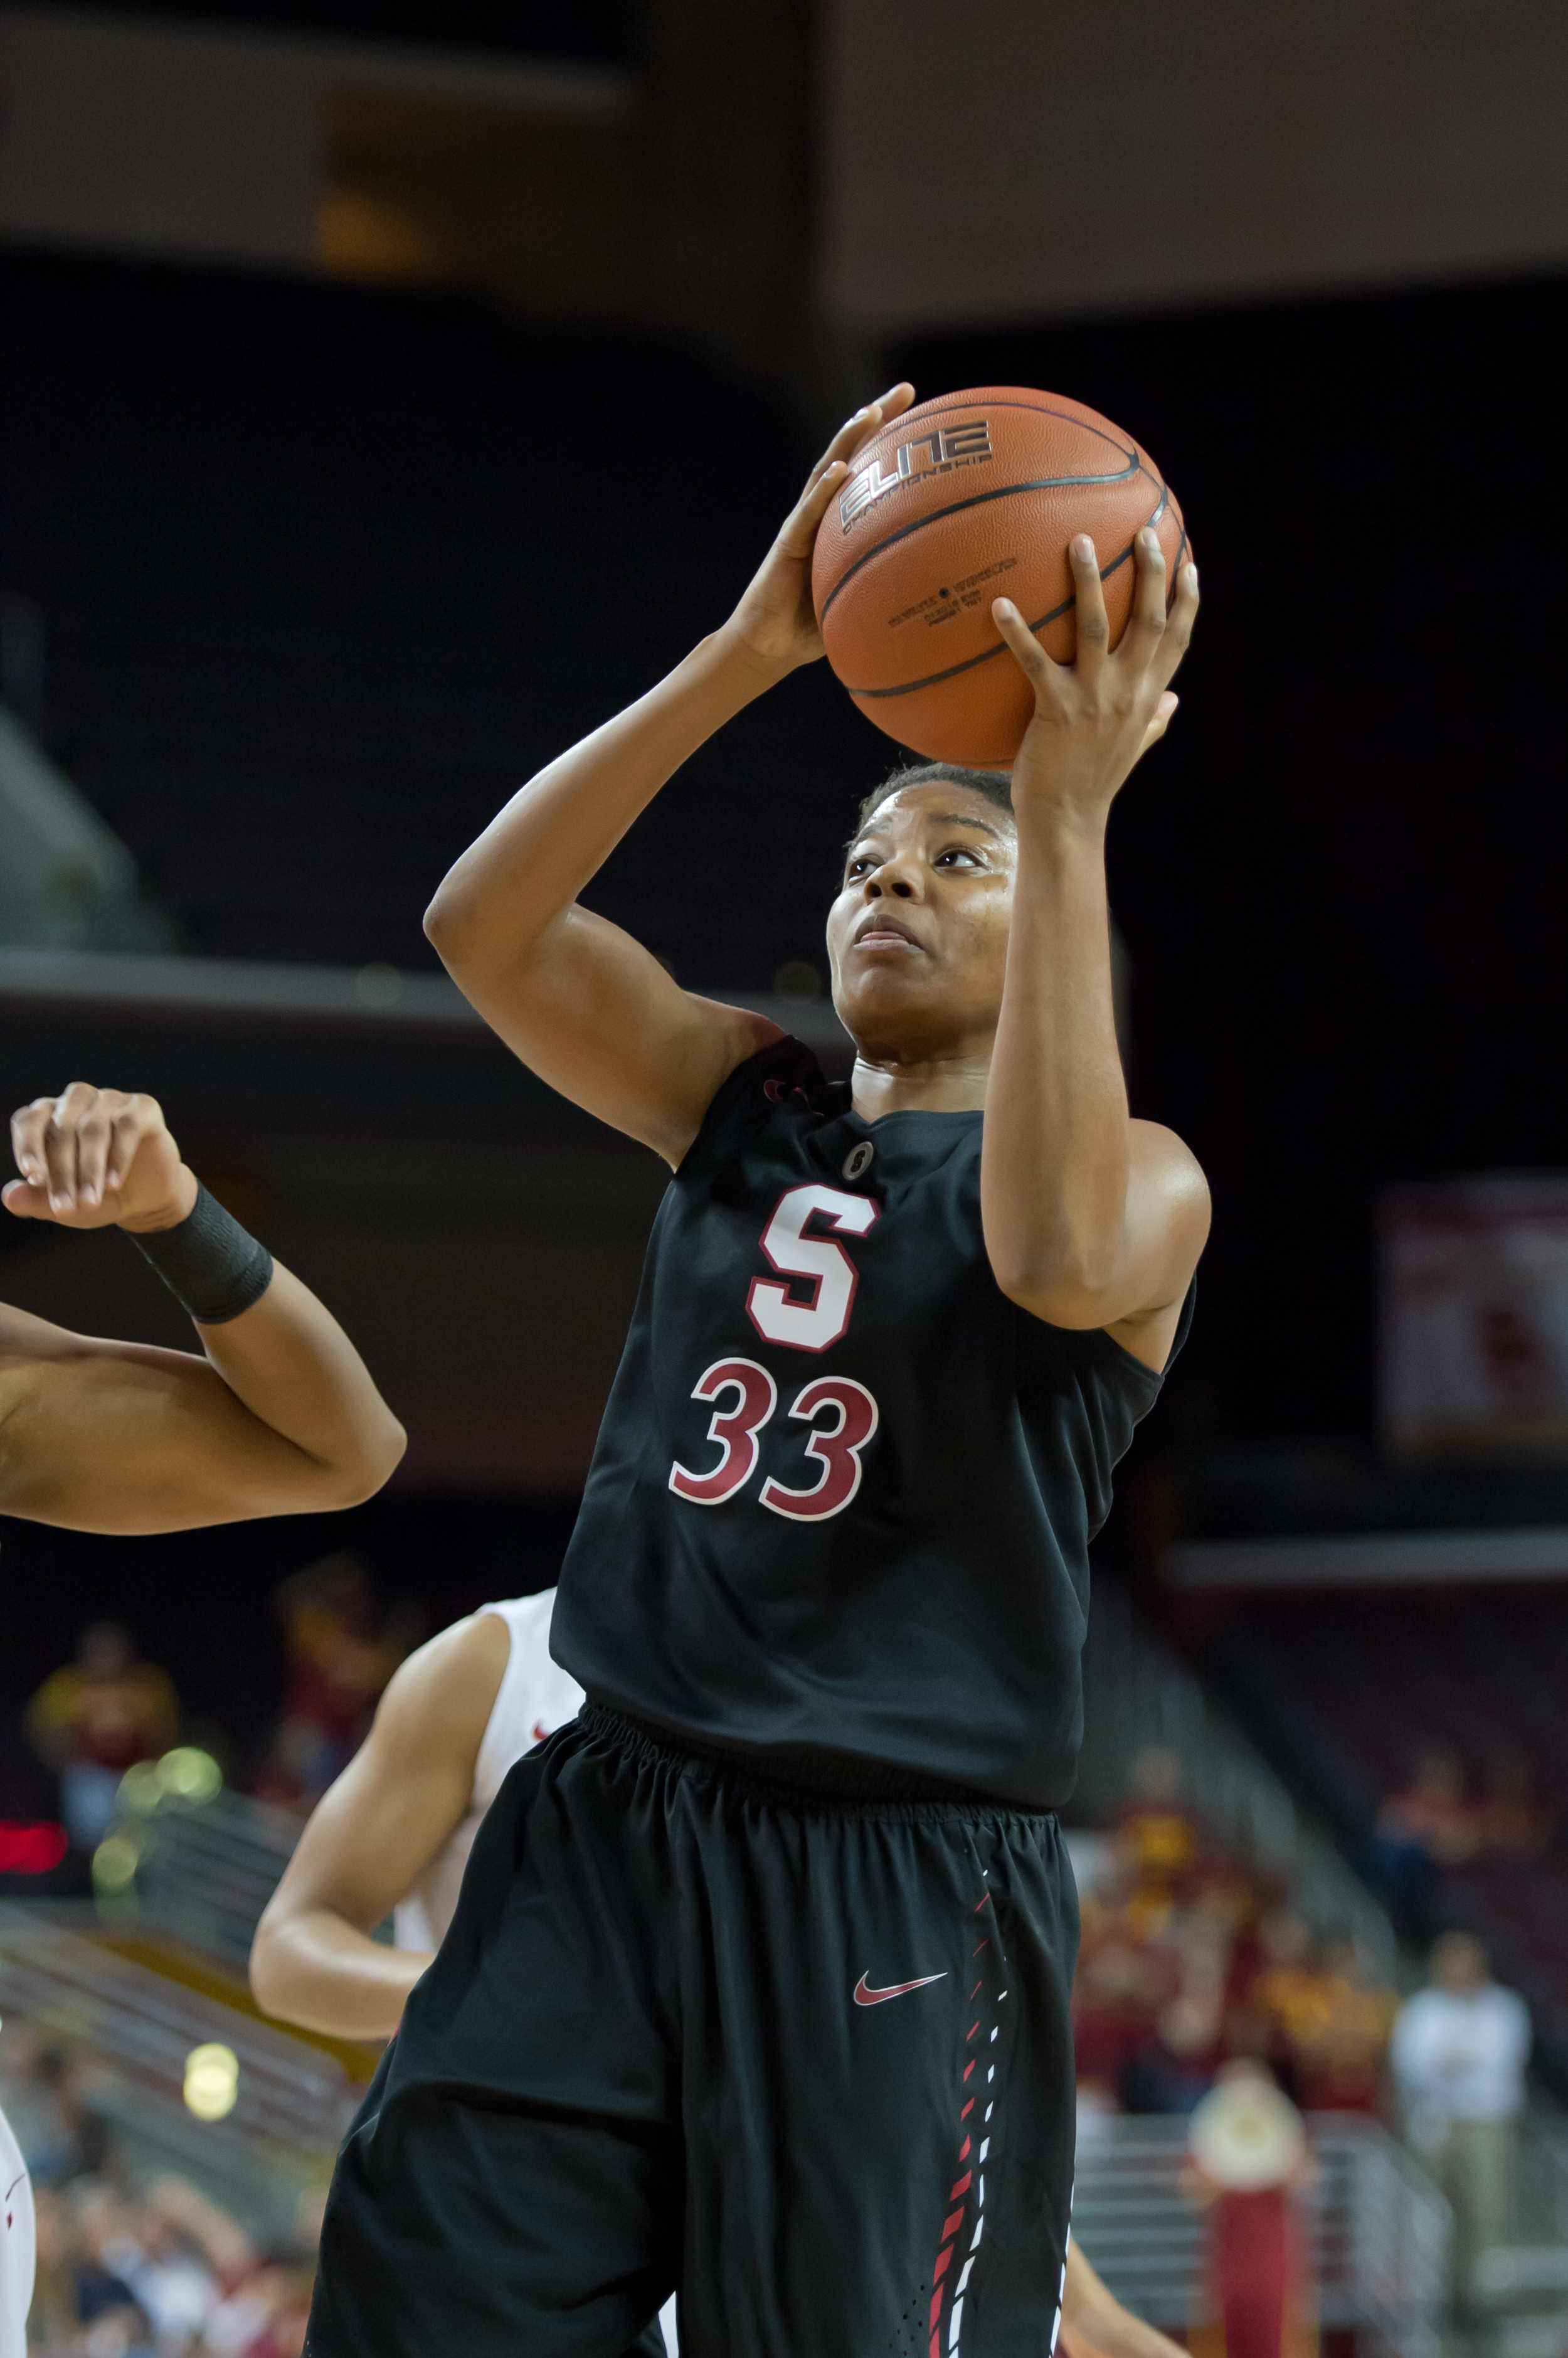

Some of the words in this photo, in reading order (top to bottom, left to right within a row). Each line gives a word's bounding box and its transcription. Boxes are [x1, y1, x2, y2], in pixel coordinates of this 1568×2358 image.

[839, 420, 992, 527] ELITE
[842, 454, 992, 536] CHAMPIONSHIP
[746, 1183, 879, 1354] S
[669, 1357, 879, 1521] 33
